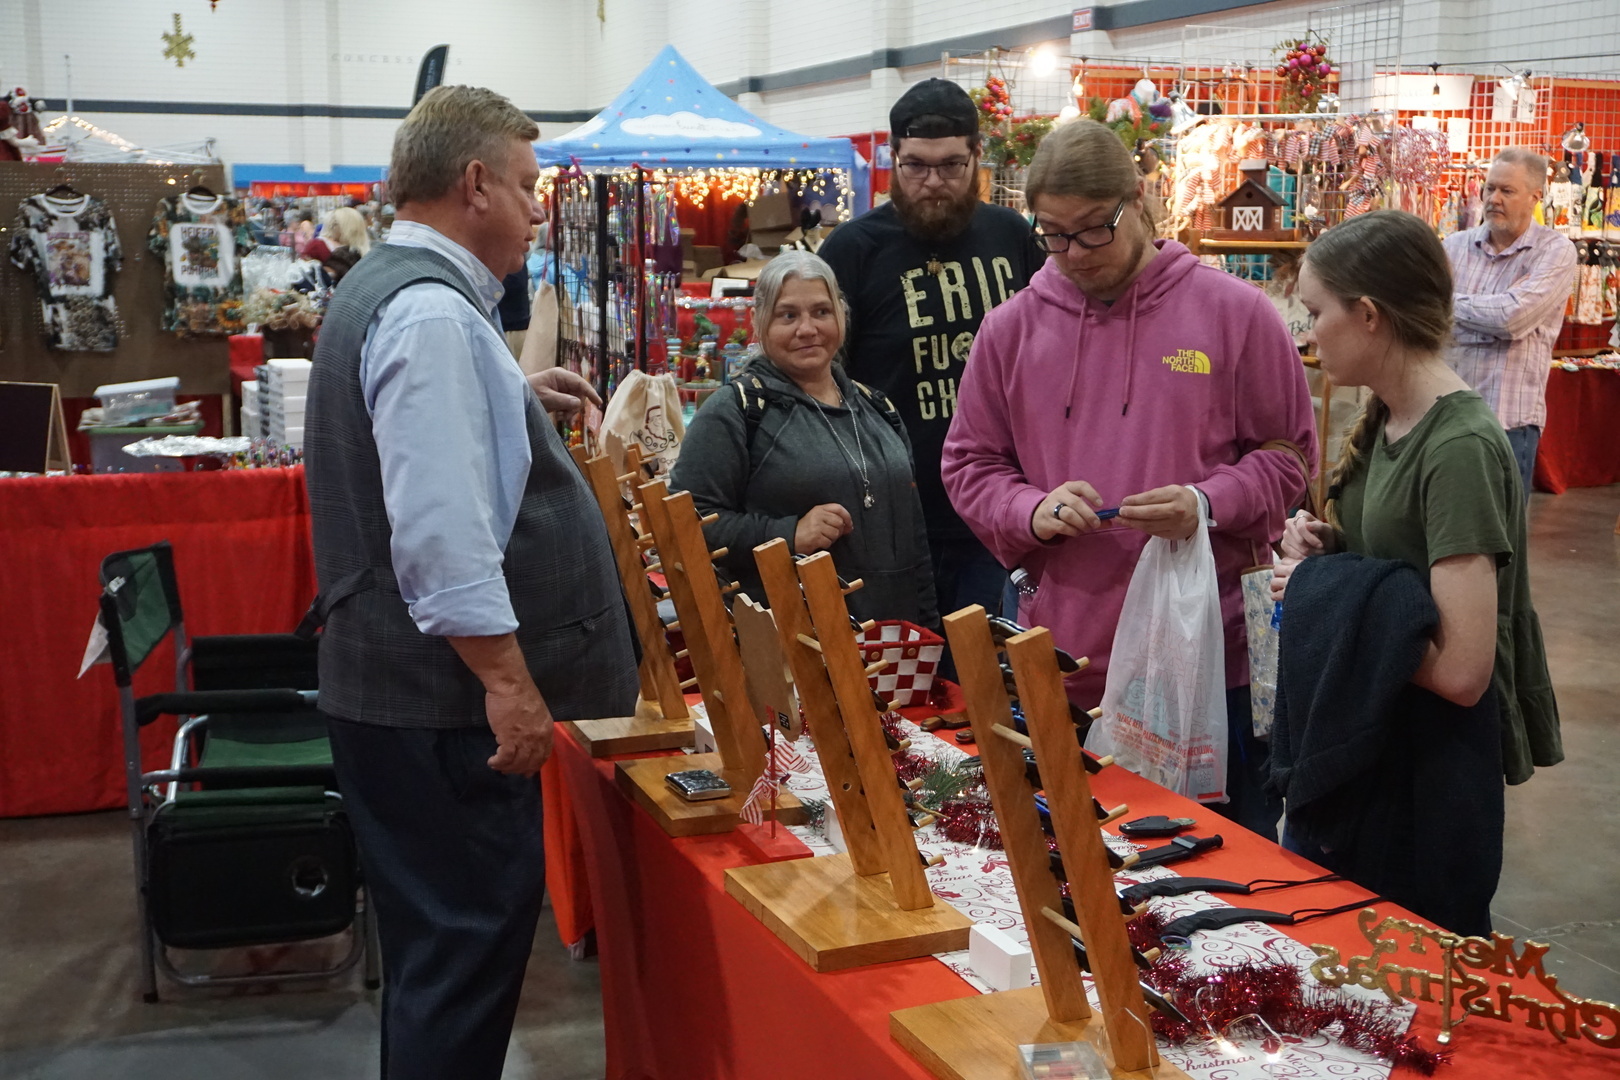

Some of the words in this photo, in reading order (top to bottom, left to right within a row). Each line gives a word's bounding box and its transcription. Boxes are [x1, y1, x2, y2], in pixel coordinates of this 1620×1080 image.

[1073, 14, 1091, 27] EXIT
[900, 256, 1014, 328] ERIC
[1176, 349, 1194, 357] THE
[1162, 356, 1194, 365] NORTH
[1171, 363, 1194, 373] FACE
[917, 378, 958, 420] CH
[929, 873, 973, 883] istmas
